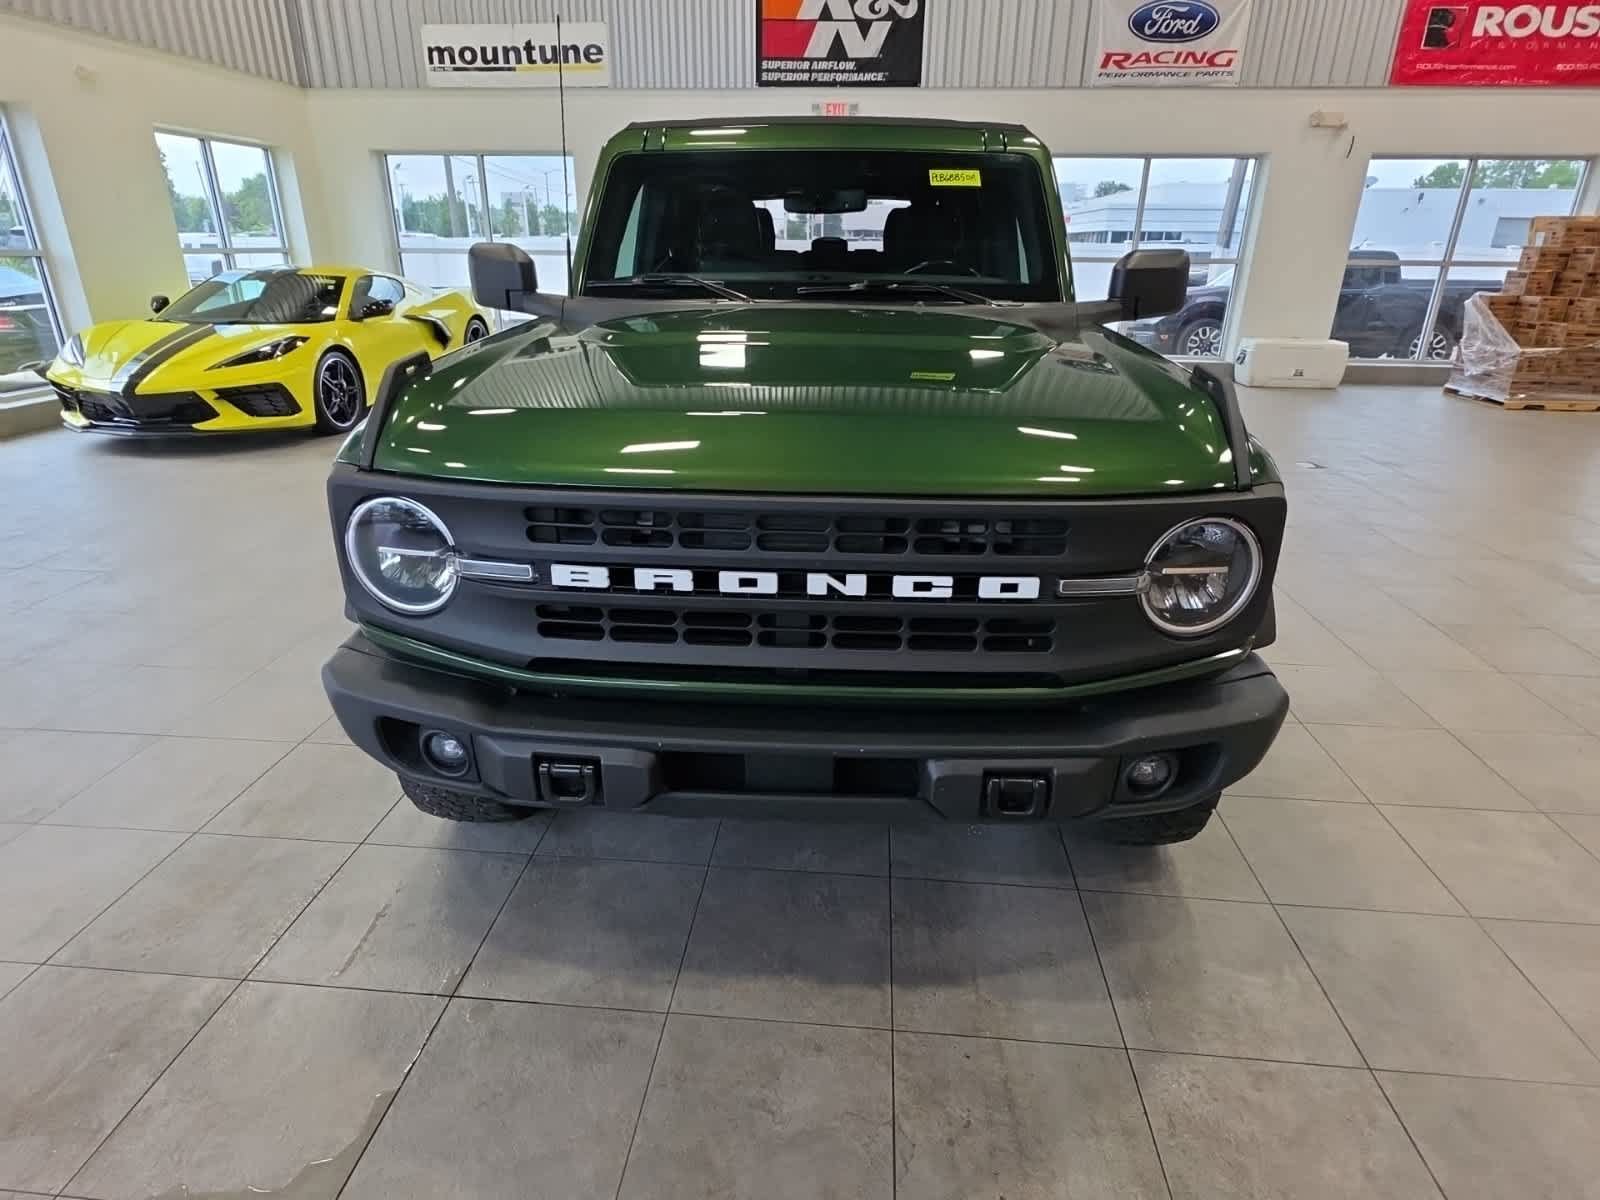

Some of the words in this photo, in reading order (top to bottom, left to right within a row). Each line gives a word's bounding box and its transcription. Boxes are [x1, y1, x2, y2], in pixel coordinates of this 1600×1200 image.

[1144, 4, 1204, 36] Ford
[1472, 4, 1600, 38] ROUS
[427, 38, 604, 66] mountune
[1100, 49, 1238, 70] RACING
[761, 60, 810, 70] SUPERIOR
[811, 61, 857, 70] AIRFLOW.
[1097, 70, 1192, 79] PERFORMANCE
[1195, 70, 1235, 78] PARTS
[761, 71, 810, 81] SUPERIOR
[825, 103, 849, 115] EXIT
[550, 563, 1041, 600] BRONCO
